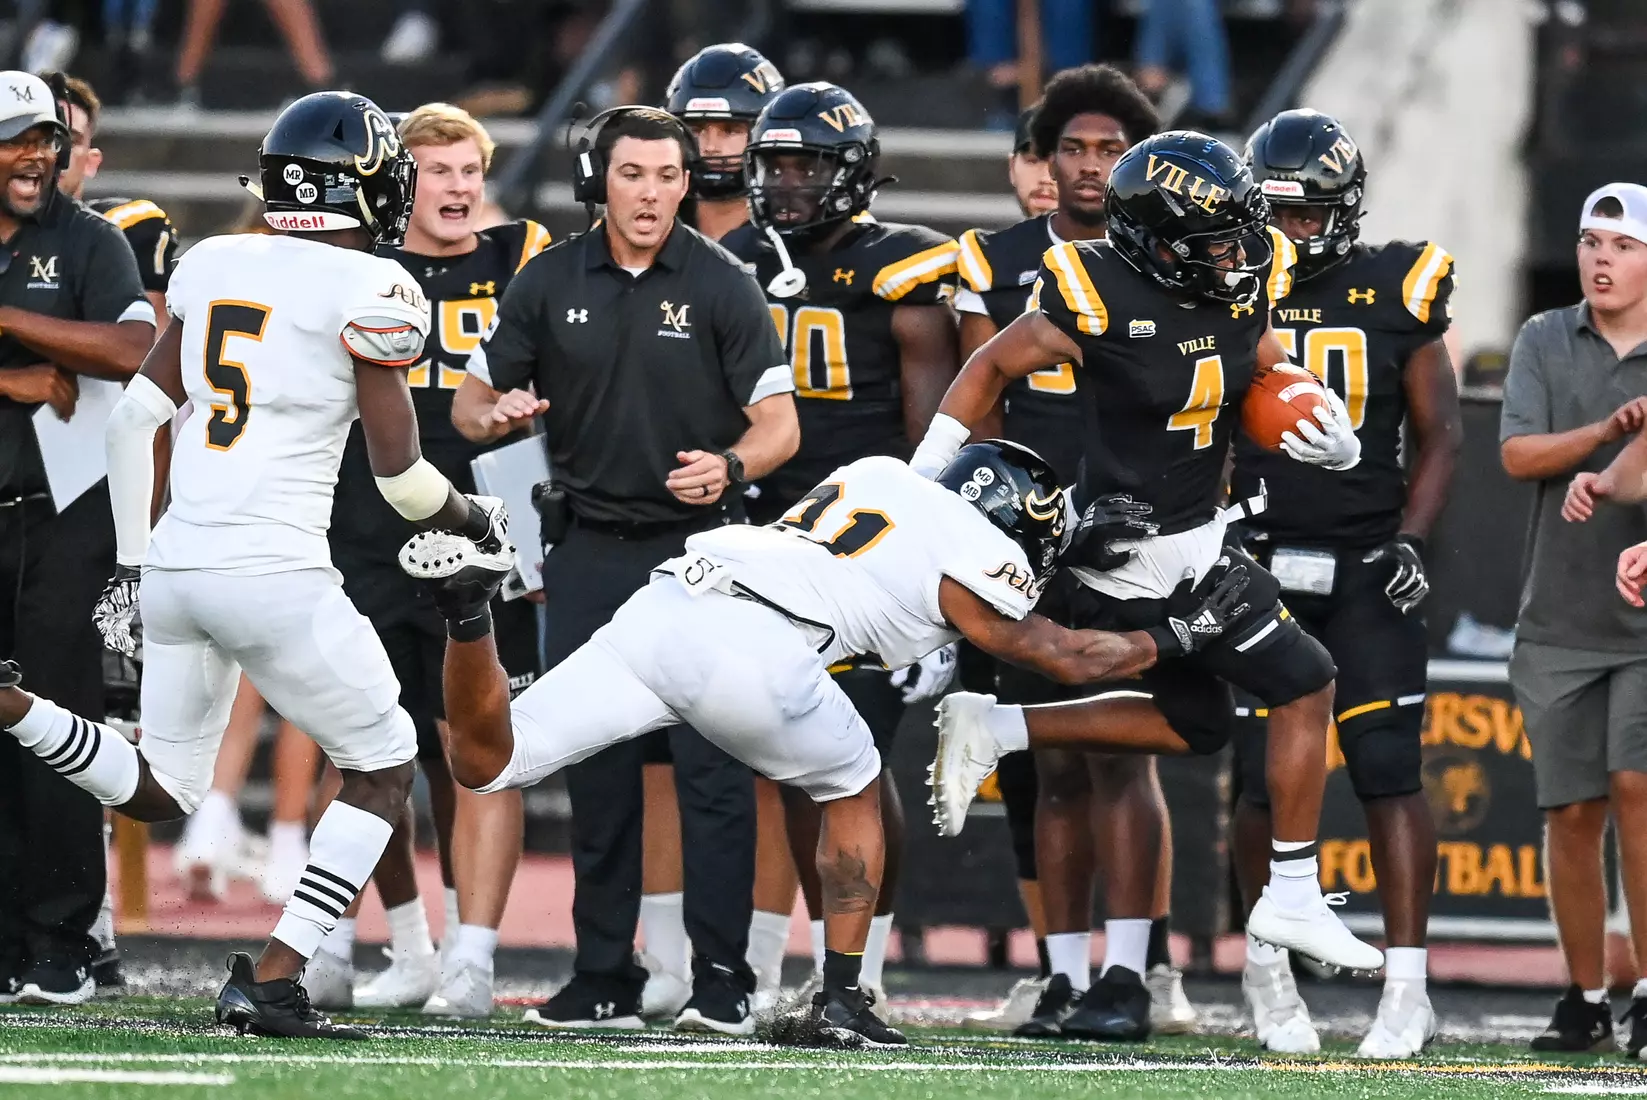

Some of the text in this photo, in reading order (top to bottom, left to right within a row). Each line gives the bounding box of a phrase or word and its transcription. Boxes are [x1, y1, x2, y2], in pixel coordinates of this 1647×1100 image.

[285, 169, 301, 181] MR
[1145, 153, 1227, 215] VILLE
[298, 187, 316, 199] MB
[267, 215, 325, 229] Riddell
[1278, 308, 1322, 323] VILLE
[1131, 325, 1154, 333] PSAC
[1177, 335, 1216, 356] VILLE
[203, 299, 273, 452] 5
[1272, 327, 1369, 431] 0
[1166, 355, 1225, 450] 4
[975, 469, 992, 487] MR
[962, 484, 980, 499] MB
[1190, 625, 1223, 634] adidas
[1320, 839, 1546, 897] FOTBAL
